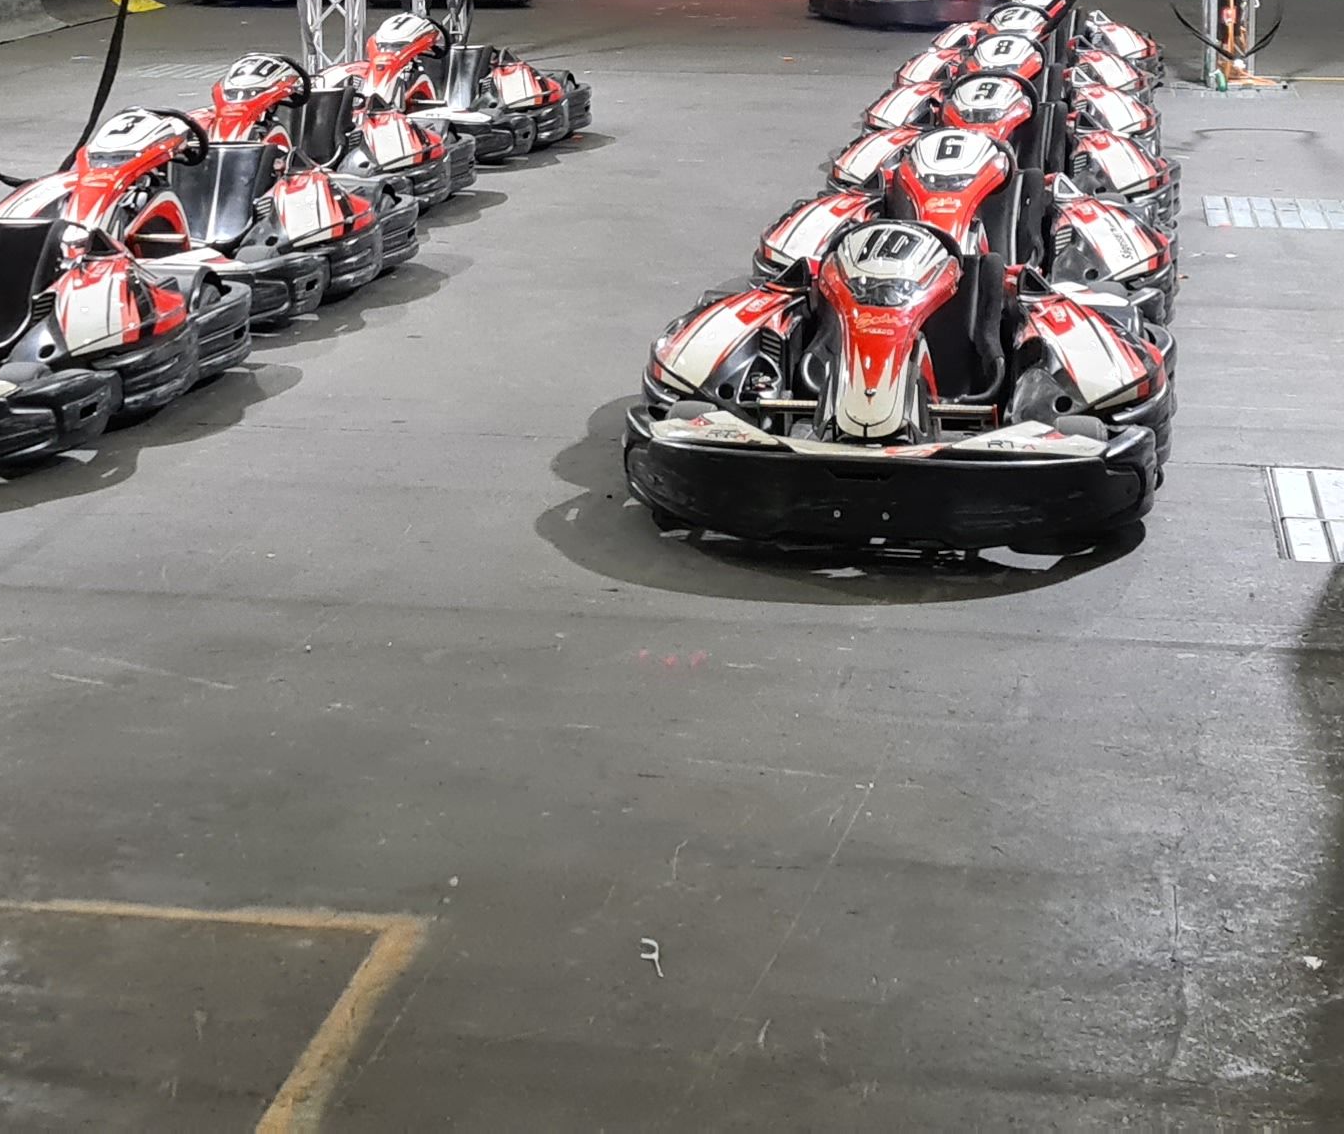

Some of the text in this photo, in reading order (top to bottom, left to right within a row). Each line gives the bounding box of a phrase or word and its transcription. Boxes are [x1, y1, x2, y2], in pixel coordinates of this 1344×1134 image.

[392, 15, 413, 31] 4
[993, 39, 1014, 56] 8
[974, 81, 1001, 100] 9
[935, 134, 966, 161] 6
[857, 228, 921, 263] 10
[706, 430, 749, 441] RTX
